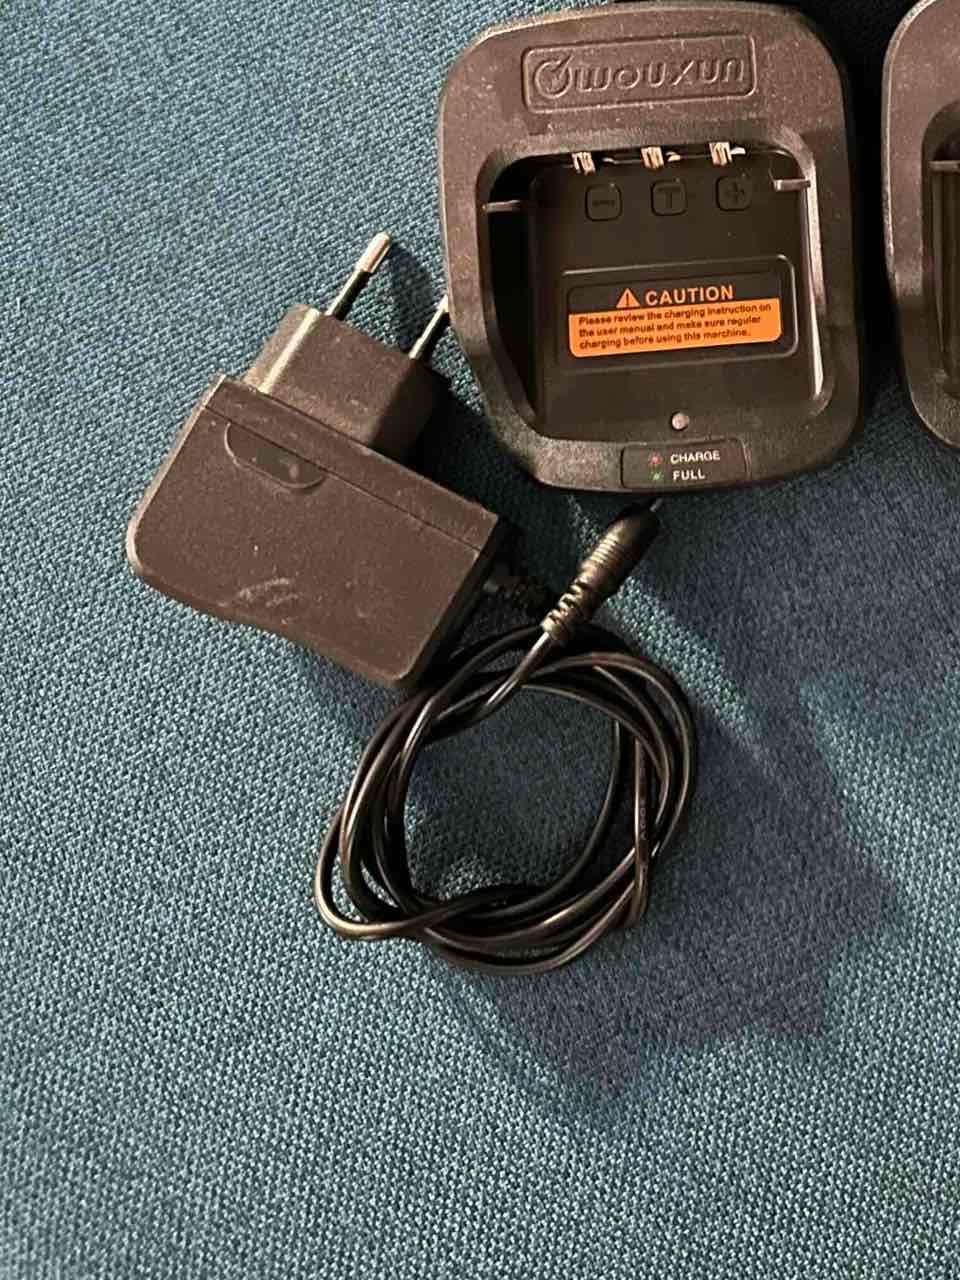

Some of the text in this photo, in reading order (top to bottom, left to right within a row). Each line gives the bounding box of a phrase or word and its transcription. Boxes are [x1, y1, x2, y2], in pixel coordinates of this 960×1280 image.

[645, 285, 733, 306] CAUTION
[579, 303, 771, 325] Please review the charging instruction on
[579, 316, 761, 338] the user manual and make sure regular
[580, 338, 621, 350] charging
[623, 336, 654, 345] before
[656, 334, 681, 344] using
[684, 331, 700, 341] this
[670, 450, 720, 464] CHARGE
[673, 469, 705, 480] FULL
